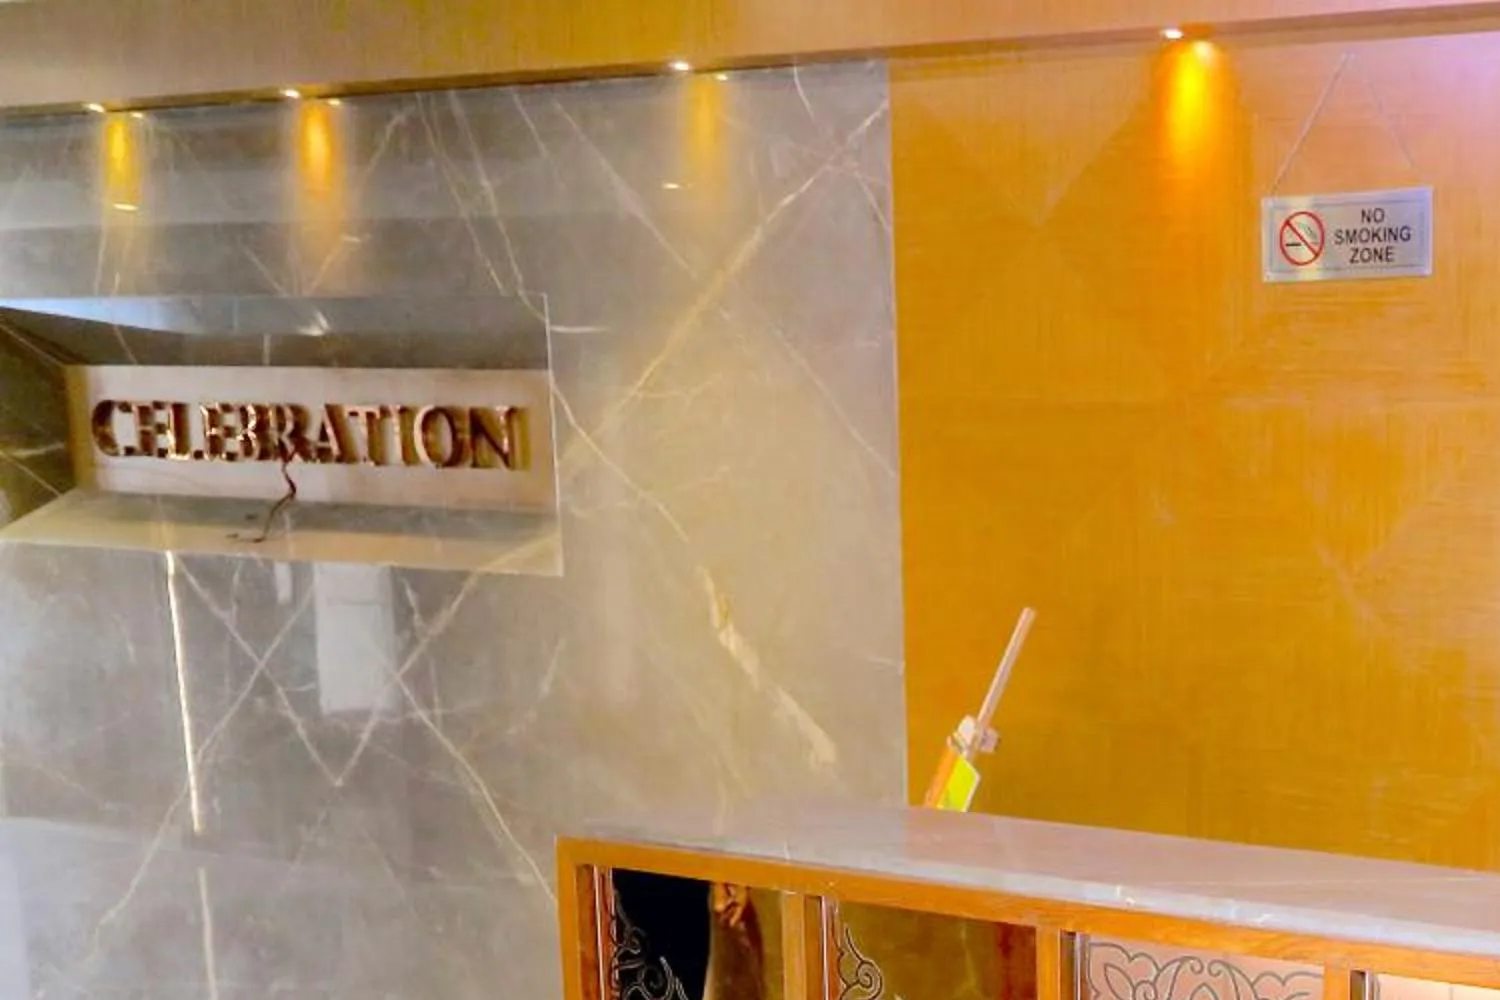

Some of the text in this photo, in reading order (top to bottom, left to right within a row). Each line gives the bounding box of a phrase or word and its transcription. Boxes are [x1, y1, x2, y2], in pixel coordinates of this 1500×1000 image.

[1361, 207, 1385, 224] NO
[1334, 225, 1412, 246] SMOKING
[1349, 246, 1396, 265] ZONE
[91, 398, 531, 472] CELEBRATION
